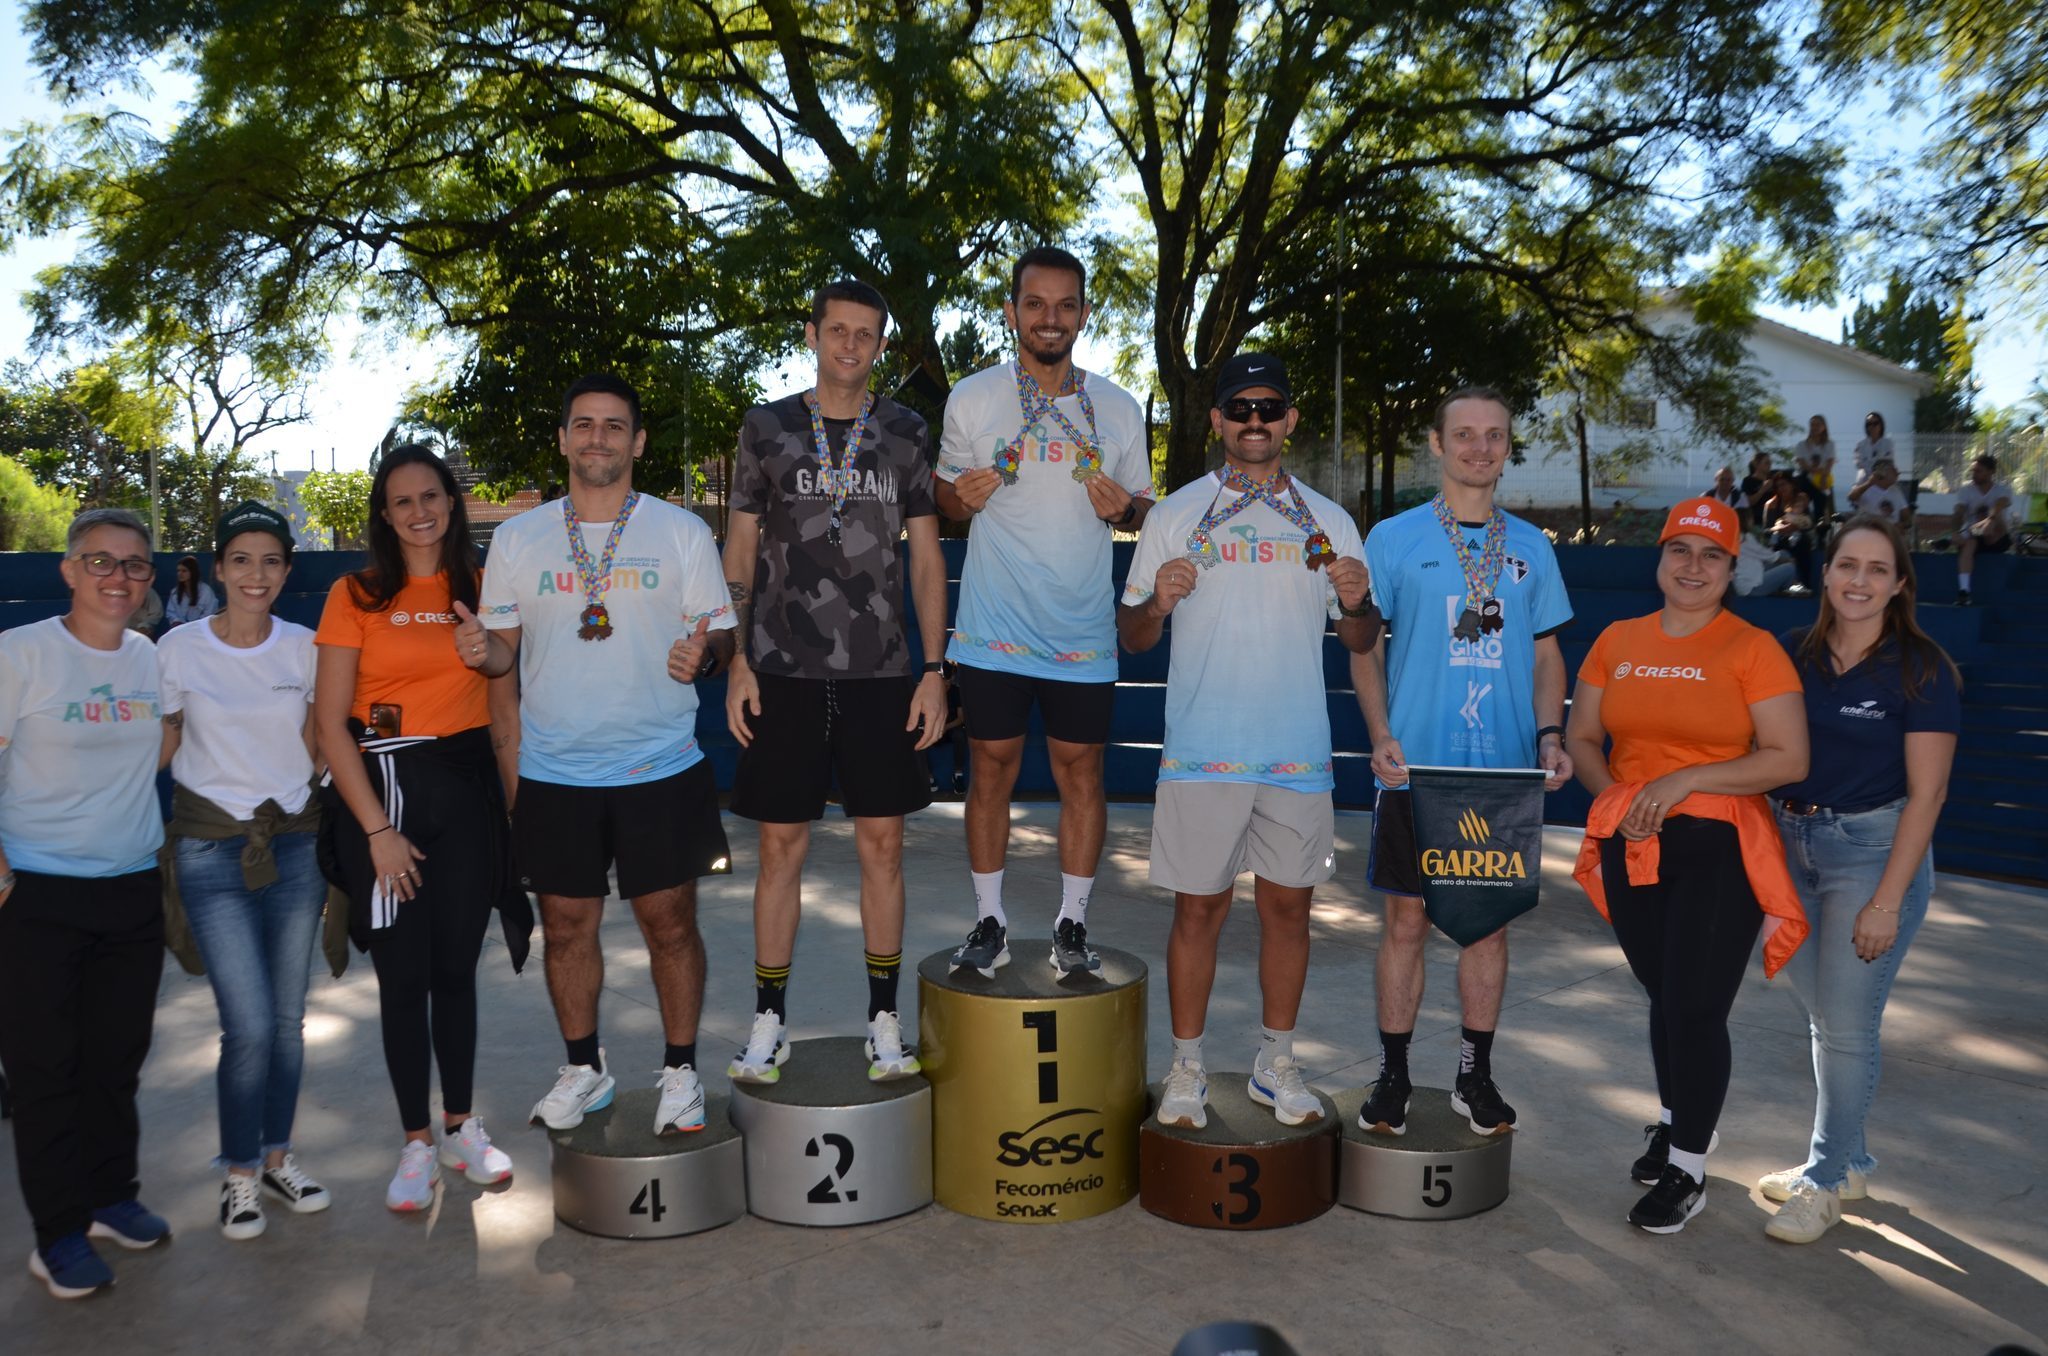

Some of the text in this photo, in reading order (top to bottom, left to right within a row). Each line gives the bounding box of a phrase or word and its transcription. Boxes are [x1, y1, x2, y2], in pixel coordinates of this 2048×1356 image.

[1679, 516, 1722, 533] CRESOL
[415, 612, 458, 623] CRES
[1635, 665, 1707, 681] CRESOL
[1421, 848, 1526, 878] GARRA
[1455, 878, 1465, 886] de
[1466, 879, 1513, 887] treinamento
[1022, 1010, 1059, 1104] 1
[1461, 1038, 1475, 1074] RUN
[996, 1121, 1104, 1167] Sesc
[805, 1132, 858, 1204] 2
[629, 1178, 667, 1223] 4
[995, 1173, 1104, 1197] Fecomércio
[1211, 1153, 1262, 1225] 3
[1421, 1164, 1453, 1208] 5
[996, 1201, 1058, 1217] Senac
